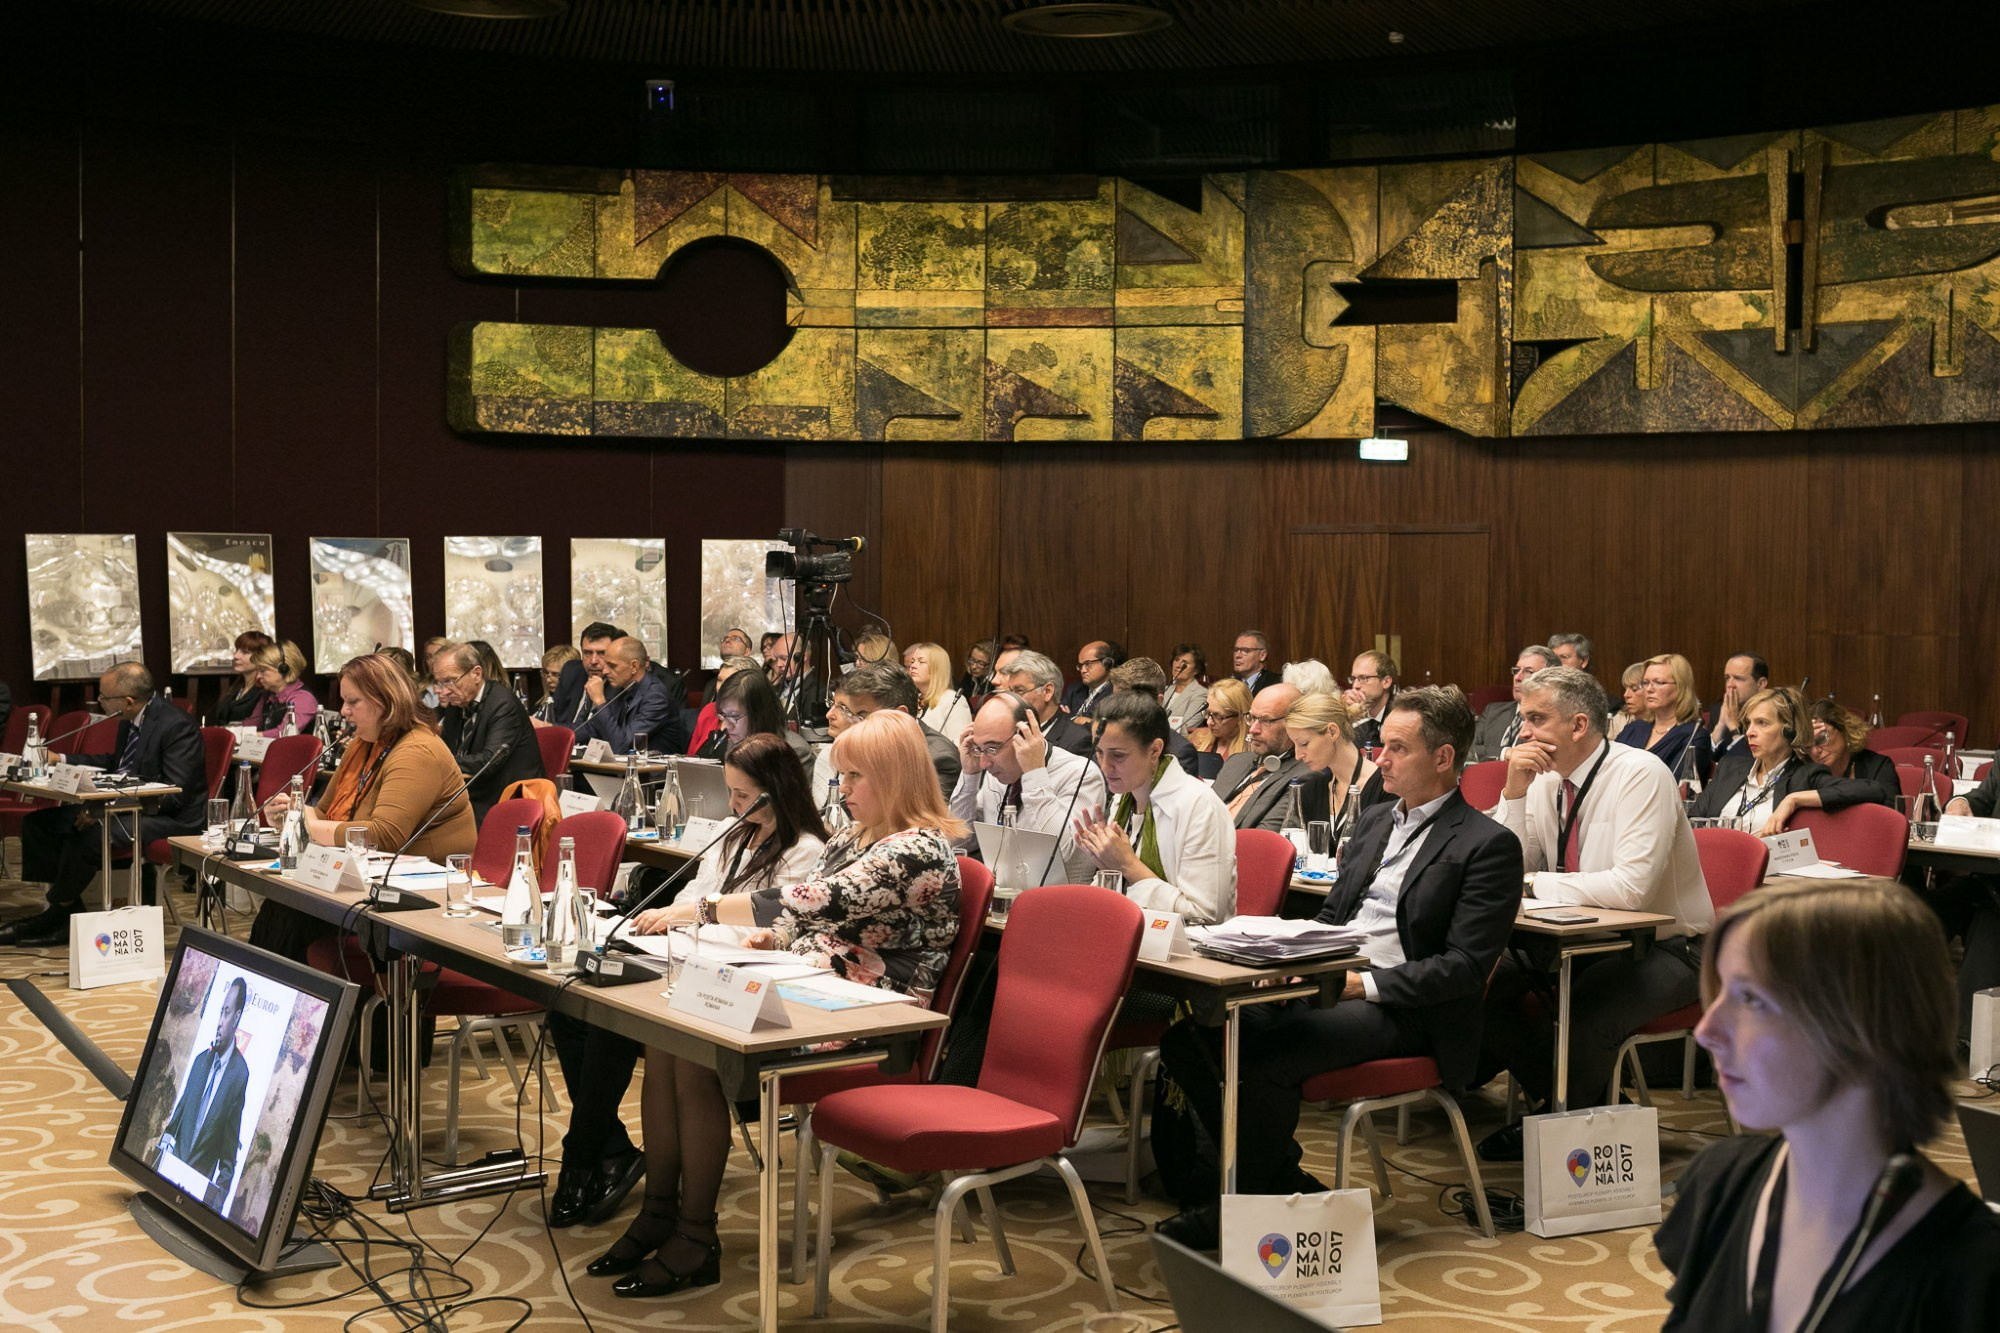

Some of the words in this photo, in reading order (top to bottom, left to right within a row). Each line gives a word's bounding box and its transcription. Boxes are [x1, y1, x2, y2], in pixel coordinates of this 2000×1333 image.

[113, 930, 128, 940] RO
[133, 929, 144, 953] 2017
[114, 940, 128, 948] MA
[114, 948, 129, 956] NIA
[1593, 1145, 1613, 1160] RO
[1594, 1160, 1614, 1174] MA
[1620, 1143, 1634, 1182] 2017
[1595, 1173, 1615, 1186] NIA
[1296, 1232, 1321, 1248] RO
[1296, 1250, 1320, 1264] MA
[1328, 1230, 1343, 1274] 2017
[1296, 1264, 1319, 1278] NIA
